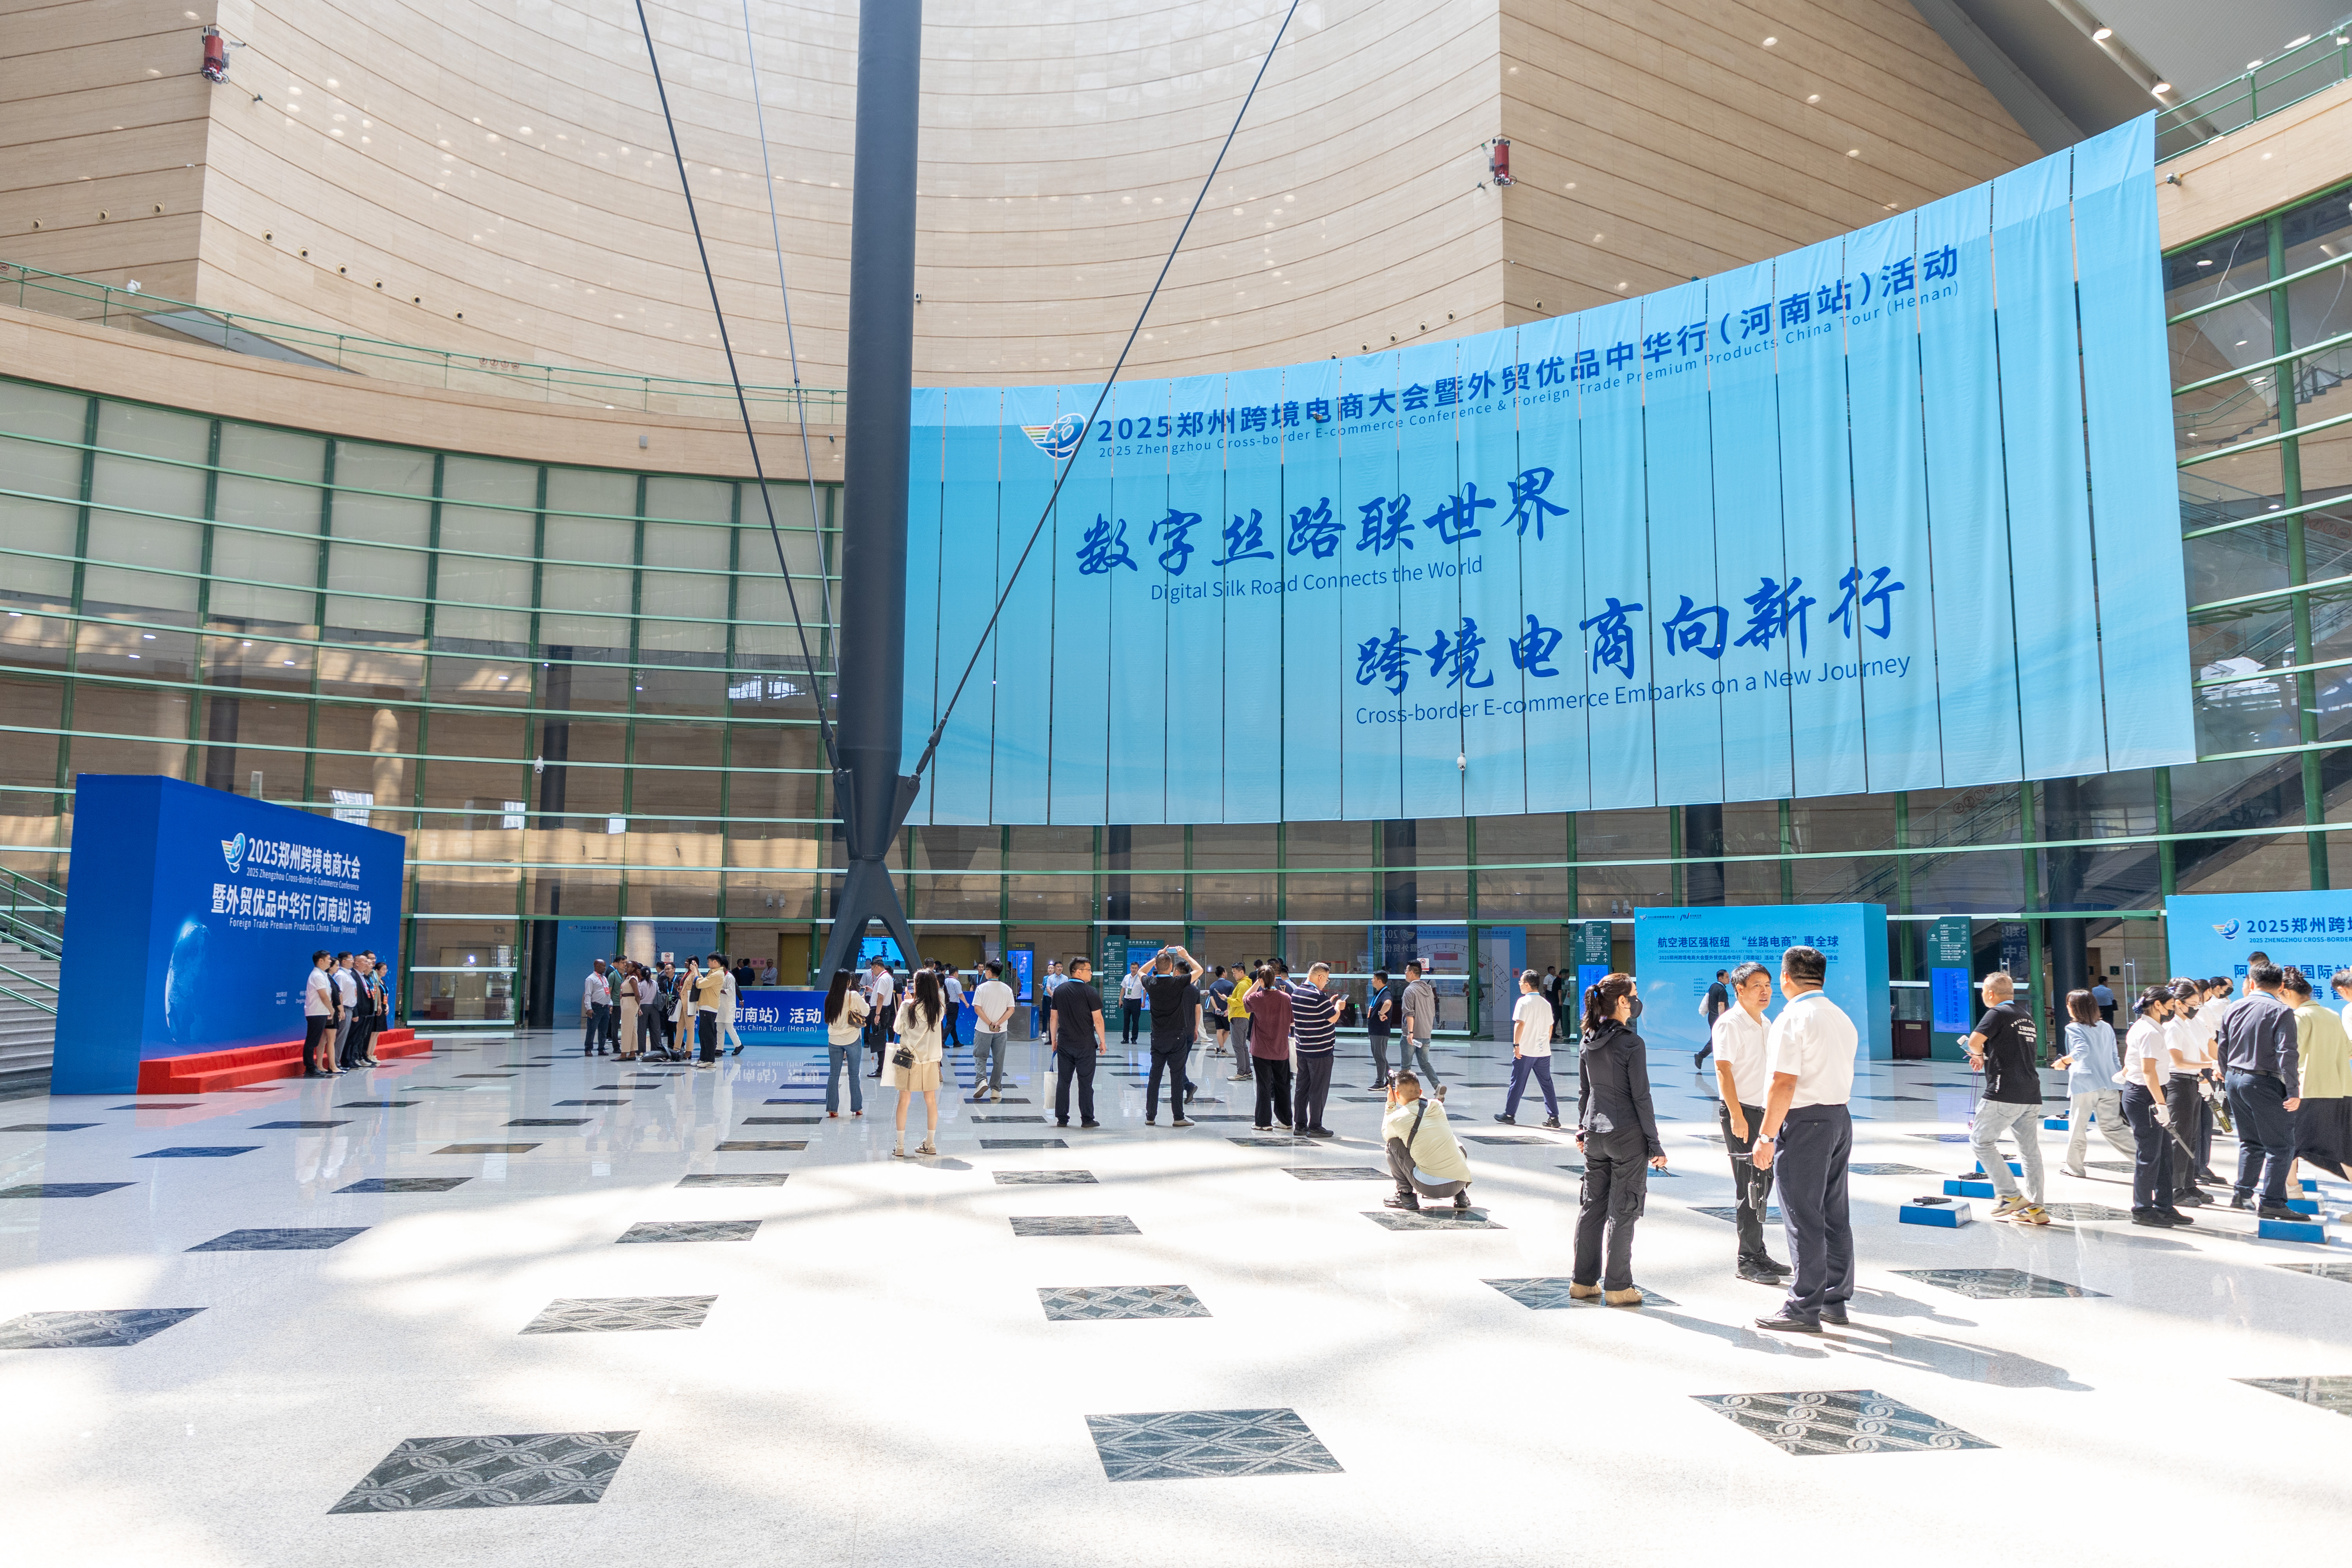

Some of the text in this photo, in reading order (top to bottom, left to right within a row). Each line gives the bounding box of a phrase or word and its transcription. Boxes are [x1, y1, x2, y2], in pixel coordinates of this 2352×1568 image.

[1099, 280, 1959, 457] 2025 Zhengzhou Cross-border E-commerce Conference & Foreign Trade Premium Products China Tour (Henan)
[1076, 466, 1570, 577] 数字丝路联世界
[1151, 555, 1483, 604] Digital Silk Road Connects the World
[1356, 567, 1905, 696] 跨境电商向新行
[1356, 654, 1911, 724] Cross-border E-commerce Embarks on a New Journey
[246, 867, 359, 891] 2025 Zhengzhou Cross-Border E-Commerce Conference
[247, 838, 360, 880] 2025郑州跨境电商大会
[211, 883, 371, 925] 暨外贸优品中华行（河南站）活动
[229, 917, 358, 935] Foreign Trade Premium Products China Tour (Henan)
[1658, 937, 1730, 947] 航空港区强枢纽
[1804, 936, 1839, 947] 惠全球
